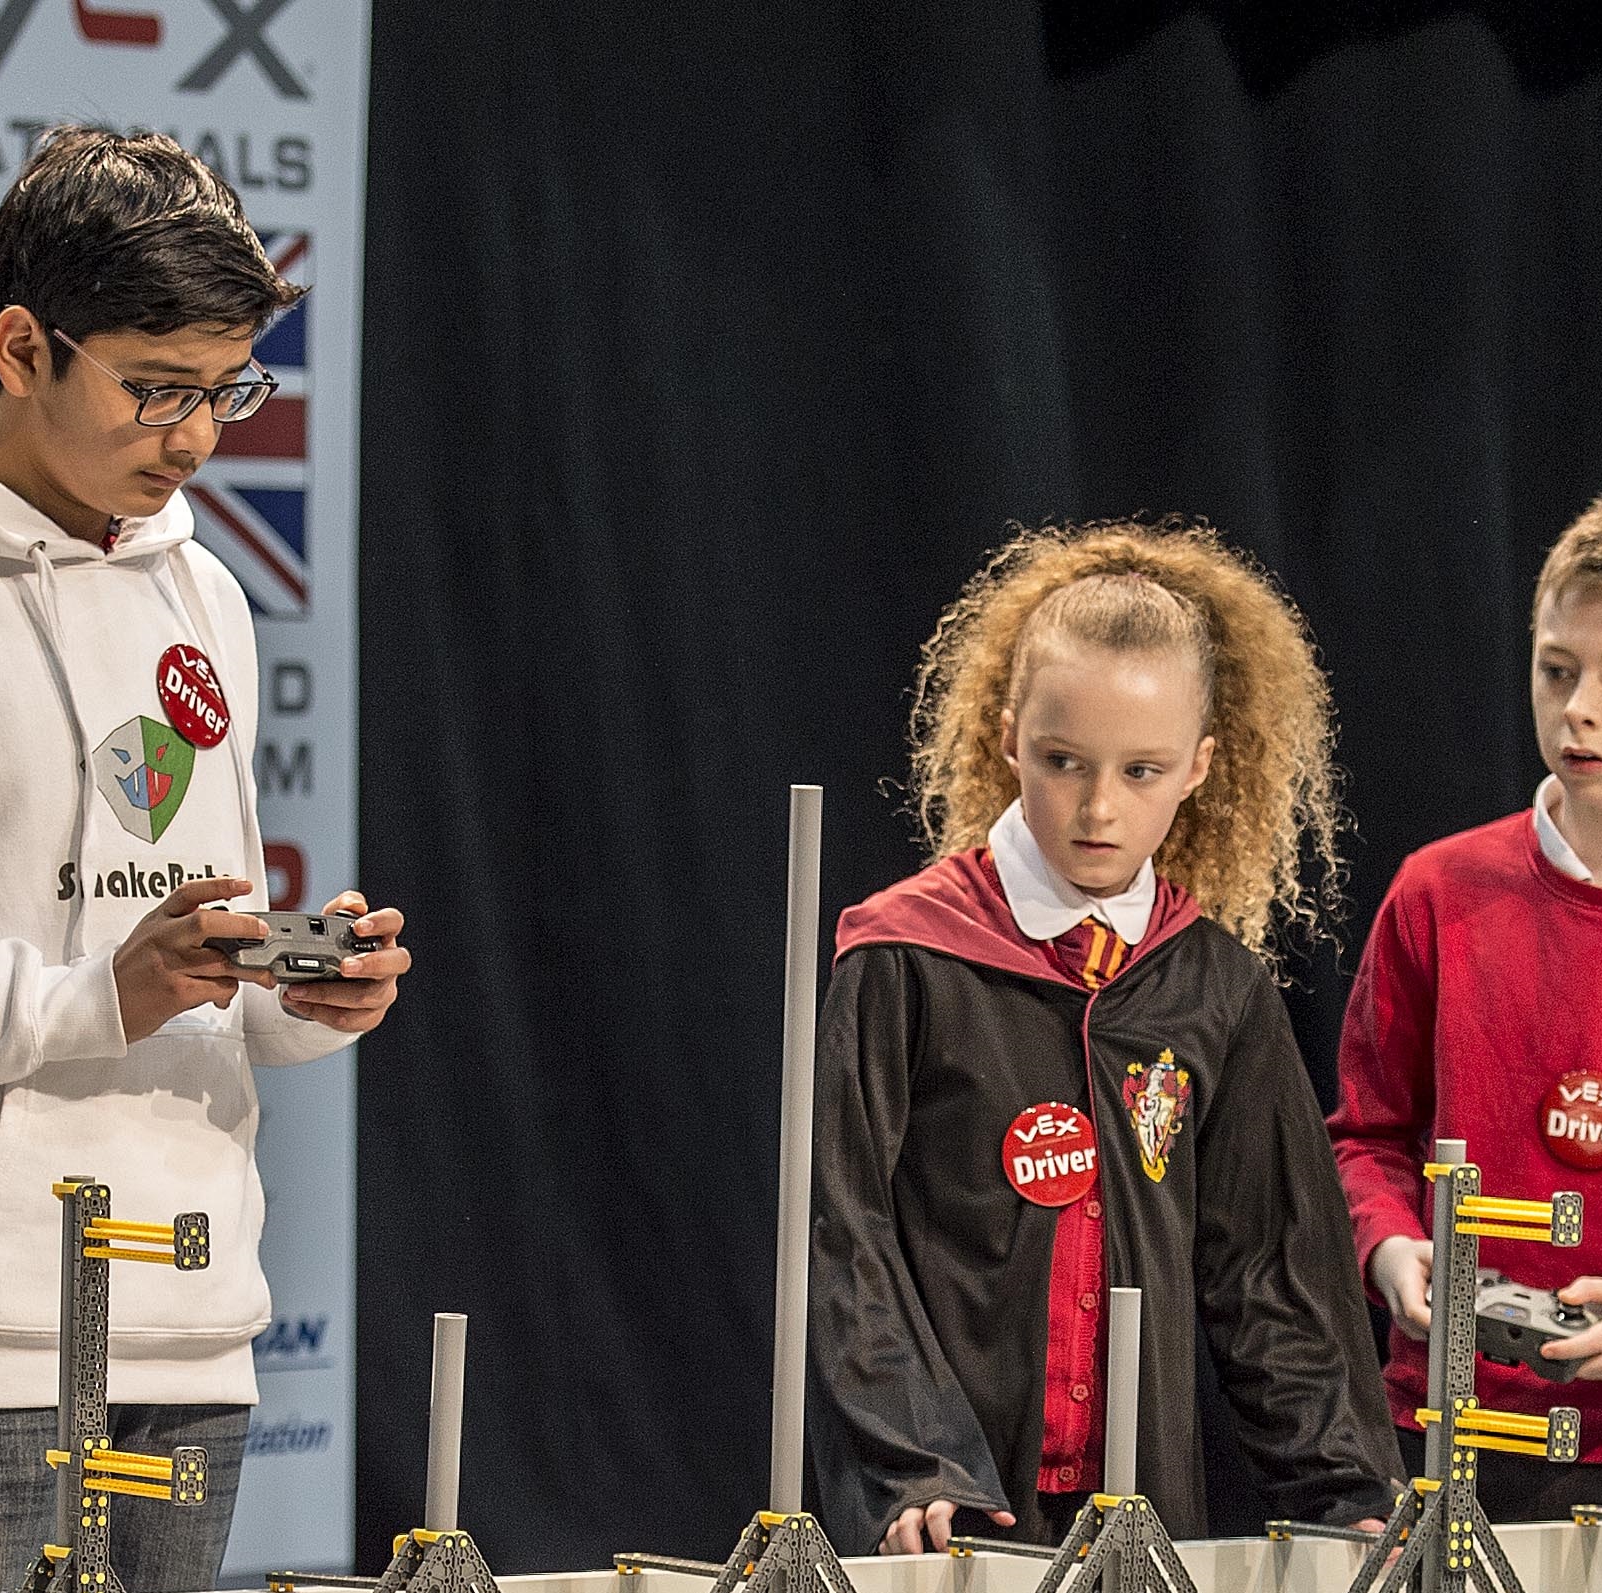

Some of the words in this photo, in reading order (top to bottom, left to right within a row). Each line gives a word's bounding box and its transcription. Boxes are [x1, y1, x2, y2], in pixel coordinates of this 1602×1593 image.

[177, 646, 223, 700] VEX
[165, 665, 226, 735] Driver
[1013, 1114, 1081, 1144] VEX
[1013, 1147, 1096, 1185] Driver
